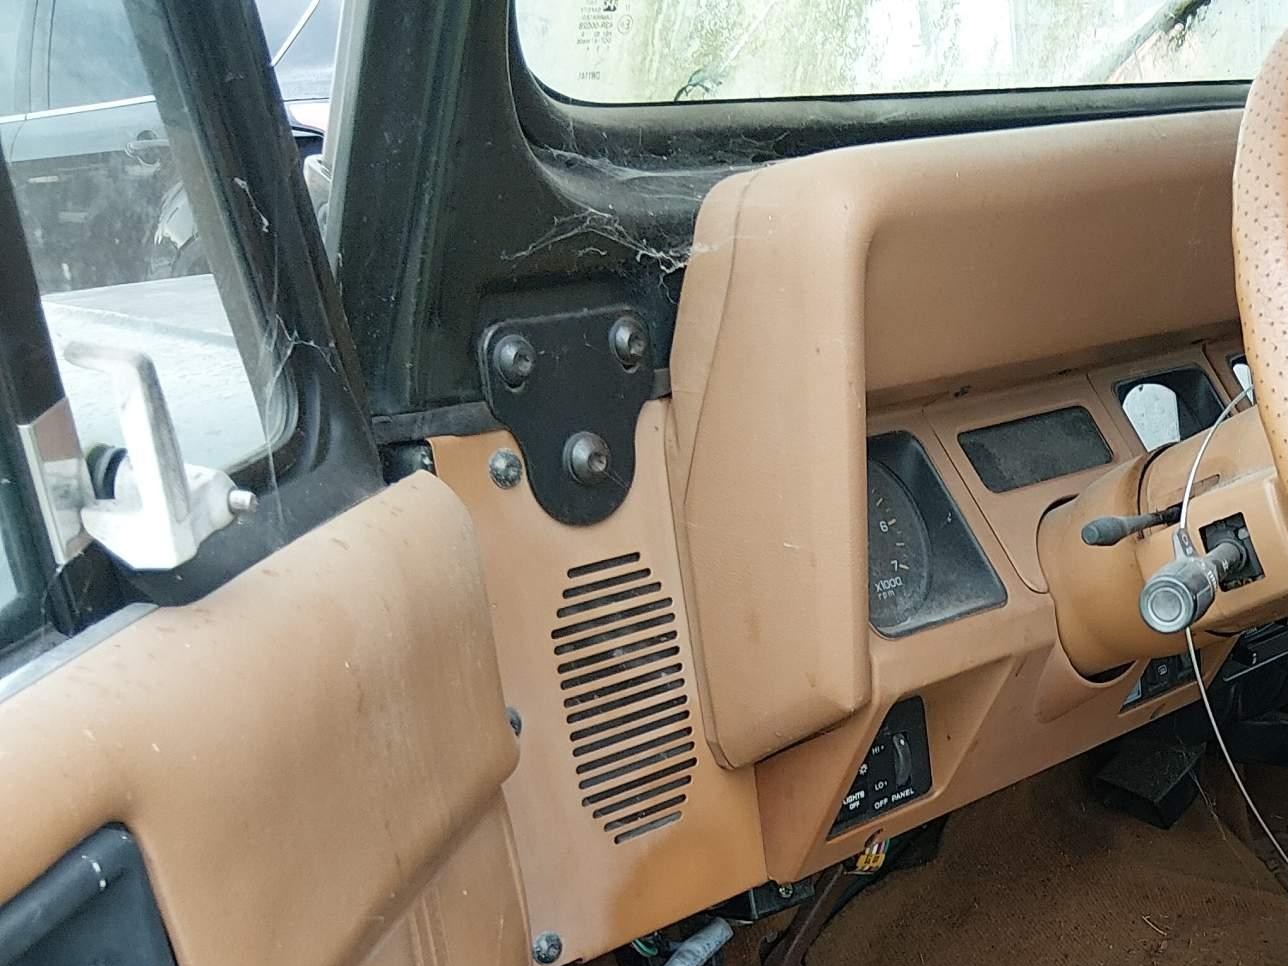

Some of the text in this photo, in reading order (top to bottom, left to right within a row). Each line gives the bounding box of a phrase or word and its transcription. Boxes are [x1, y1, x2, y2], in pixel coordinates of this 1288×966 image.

[880, 521, 888, 532] 6
[891, 560, 898, 572] 7
[878, 590, 894, 600] rpm
[874, 788, 914, 809] OFF PANEL
